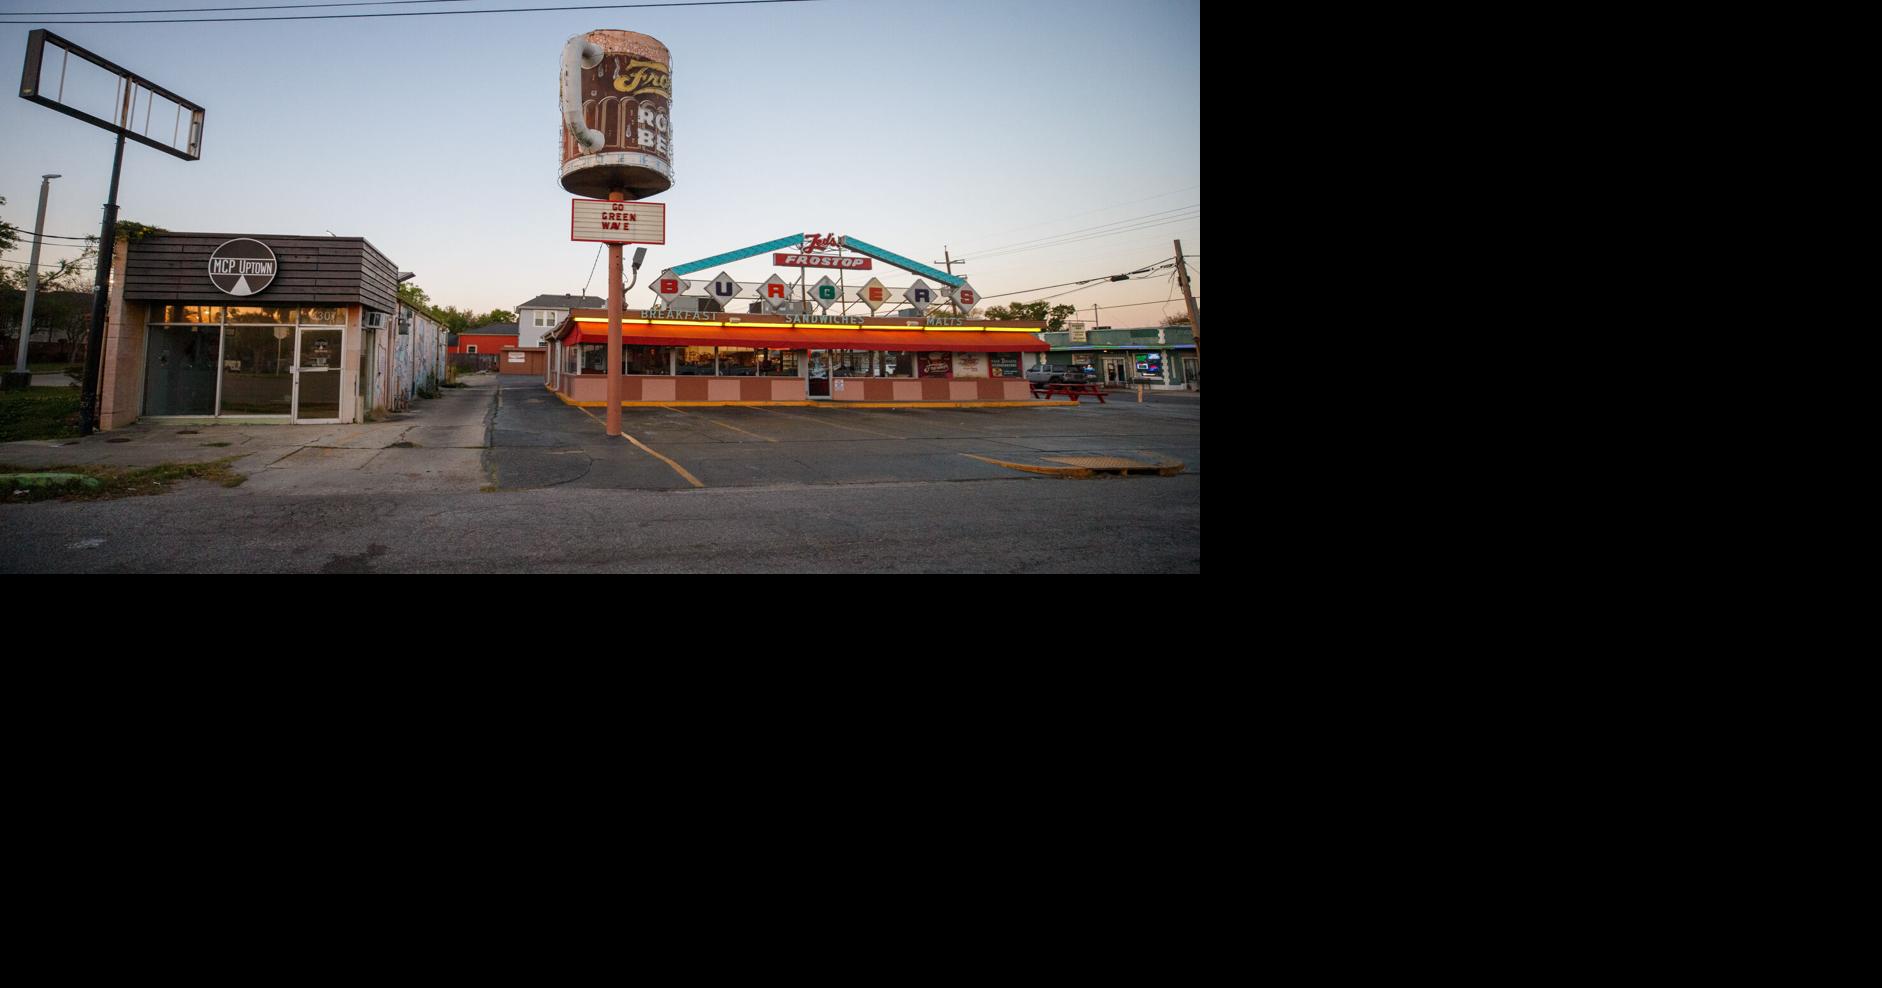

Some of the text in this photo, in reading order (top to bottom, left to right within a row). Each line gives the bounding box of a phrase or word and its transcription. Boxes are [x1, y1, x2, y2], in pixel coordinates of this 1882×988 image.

[612, 203, 624, 211] GO
[602, 212, 637, 222] GREEN
[213, 259, 236, 273] MCP
[785, 255, 864, 267] FROSTOP
[640, 309, 718, 321] BREAKFAST
[785, 313, 865, 324] SANDWICHES
[926, 317, 963, 326] MALTS
